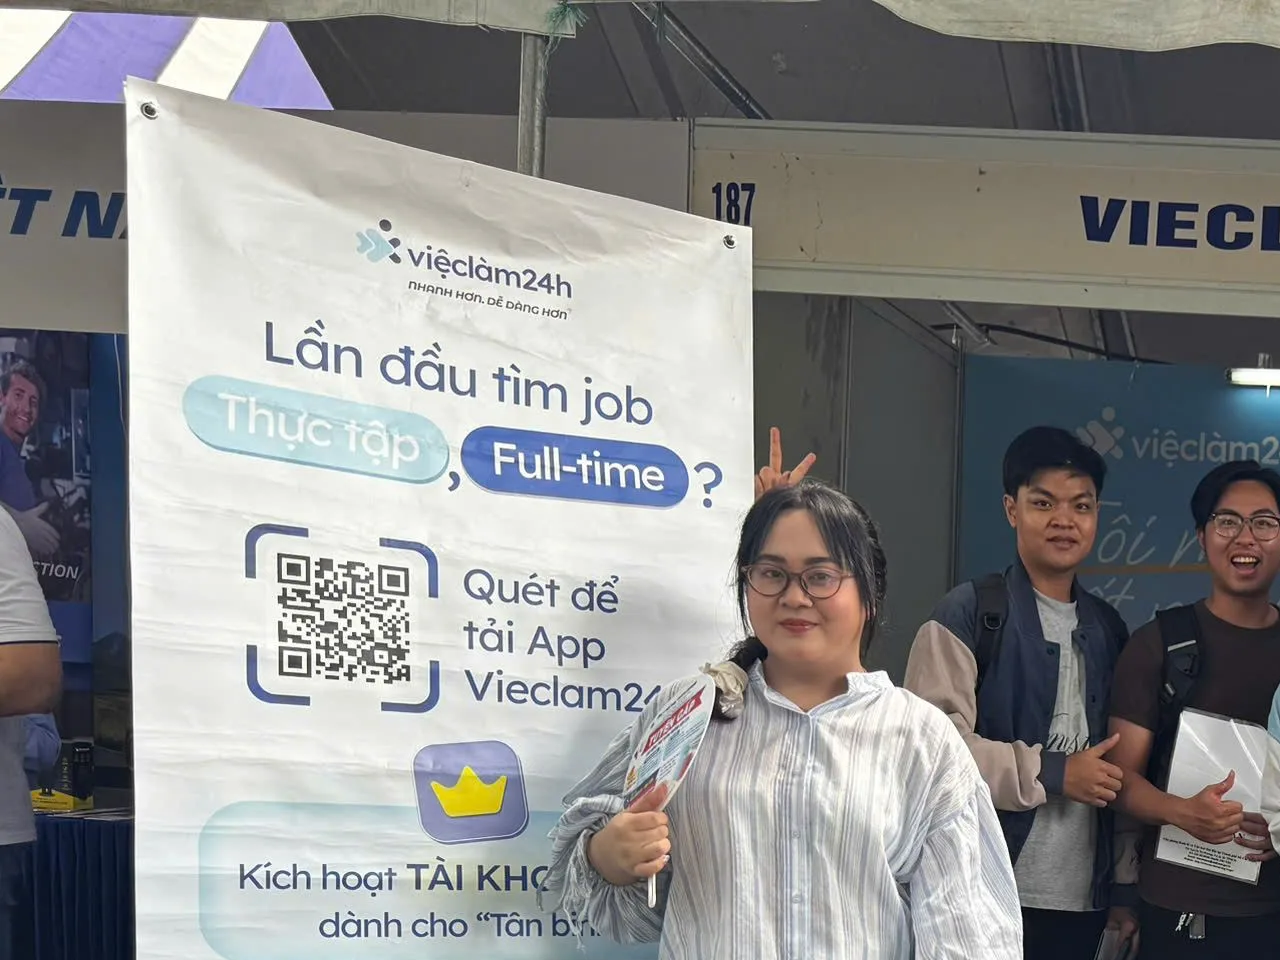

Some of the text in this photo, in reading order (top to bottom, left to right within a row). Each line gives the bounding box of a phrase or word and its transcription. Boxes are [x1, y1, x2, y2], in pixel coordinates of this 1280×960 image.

[712, 182, 755, 226] 187
[407, 246, 572, 298] việclàm24h
[265, 320, 652, 426] Lần đầu tìm job
[217, 391, 331, 456] Thực
[343, 421, 419, 472] tập
[493, 441, 664, 492] Full-time
[464, 569, 619, 613] Quét để
[463, 617, 606, 668] tải App
[239, 862, 311, 890] Kích
[322, 865, 396, 897] hoạt
[406, 855, 463, 892] TÀI
[319, 911, 401, 938] dành
[412, 912, 468, 938] cho
